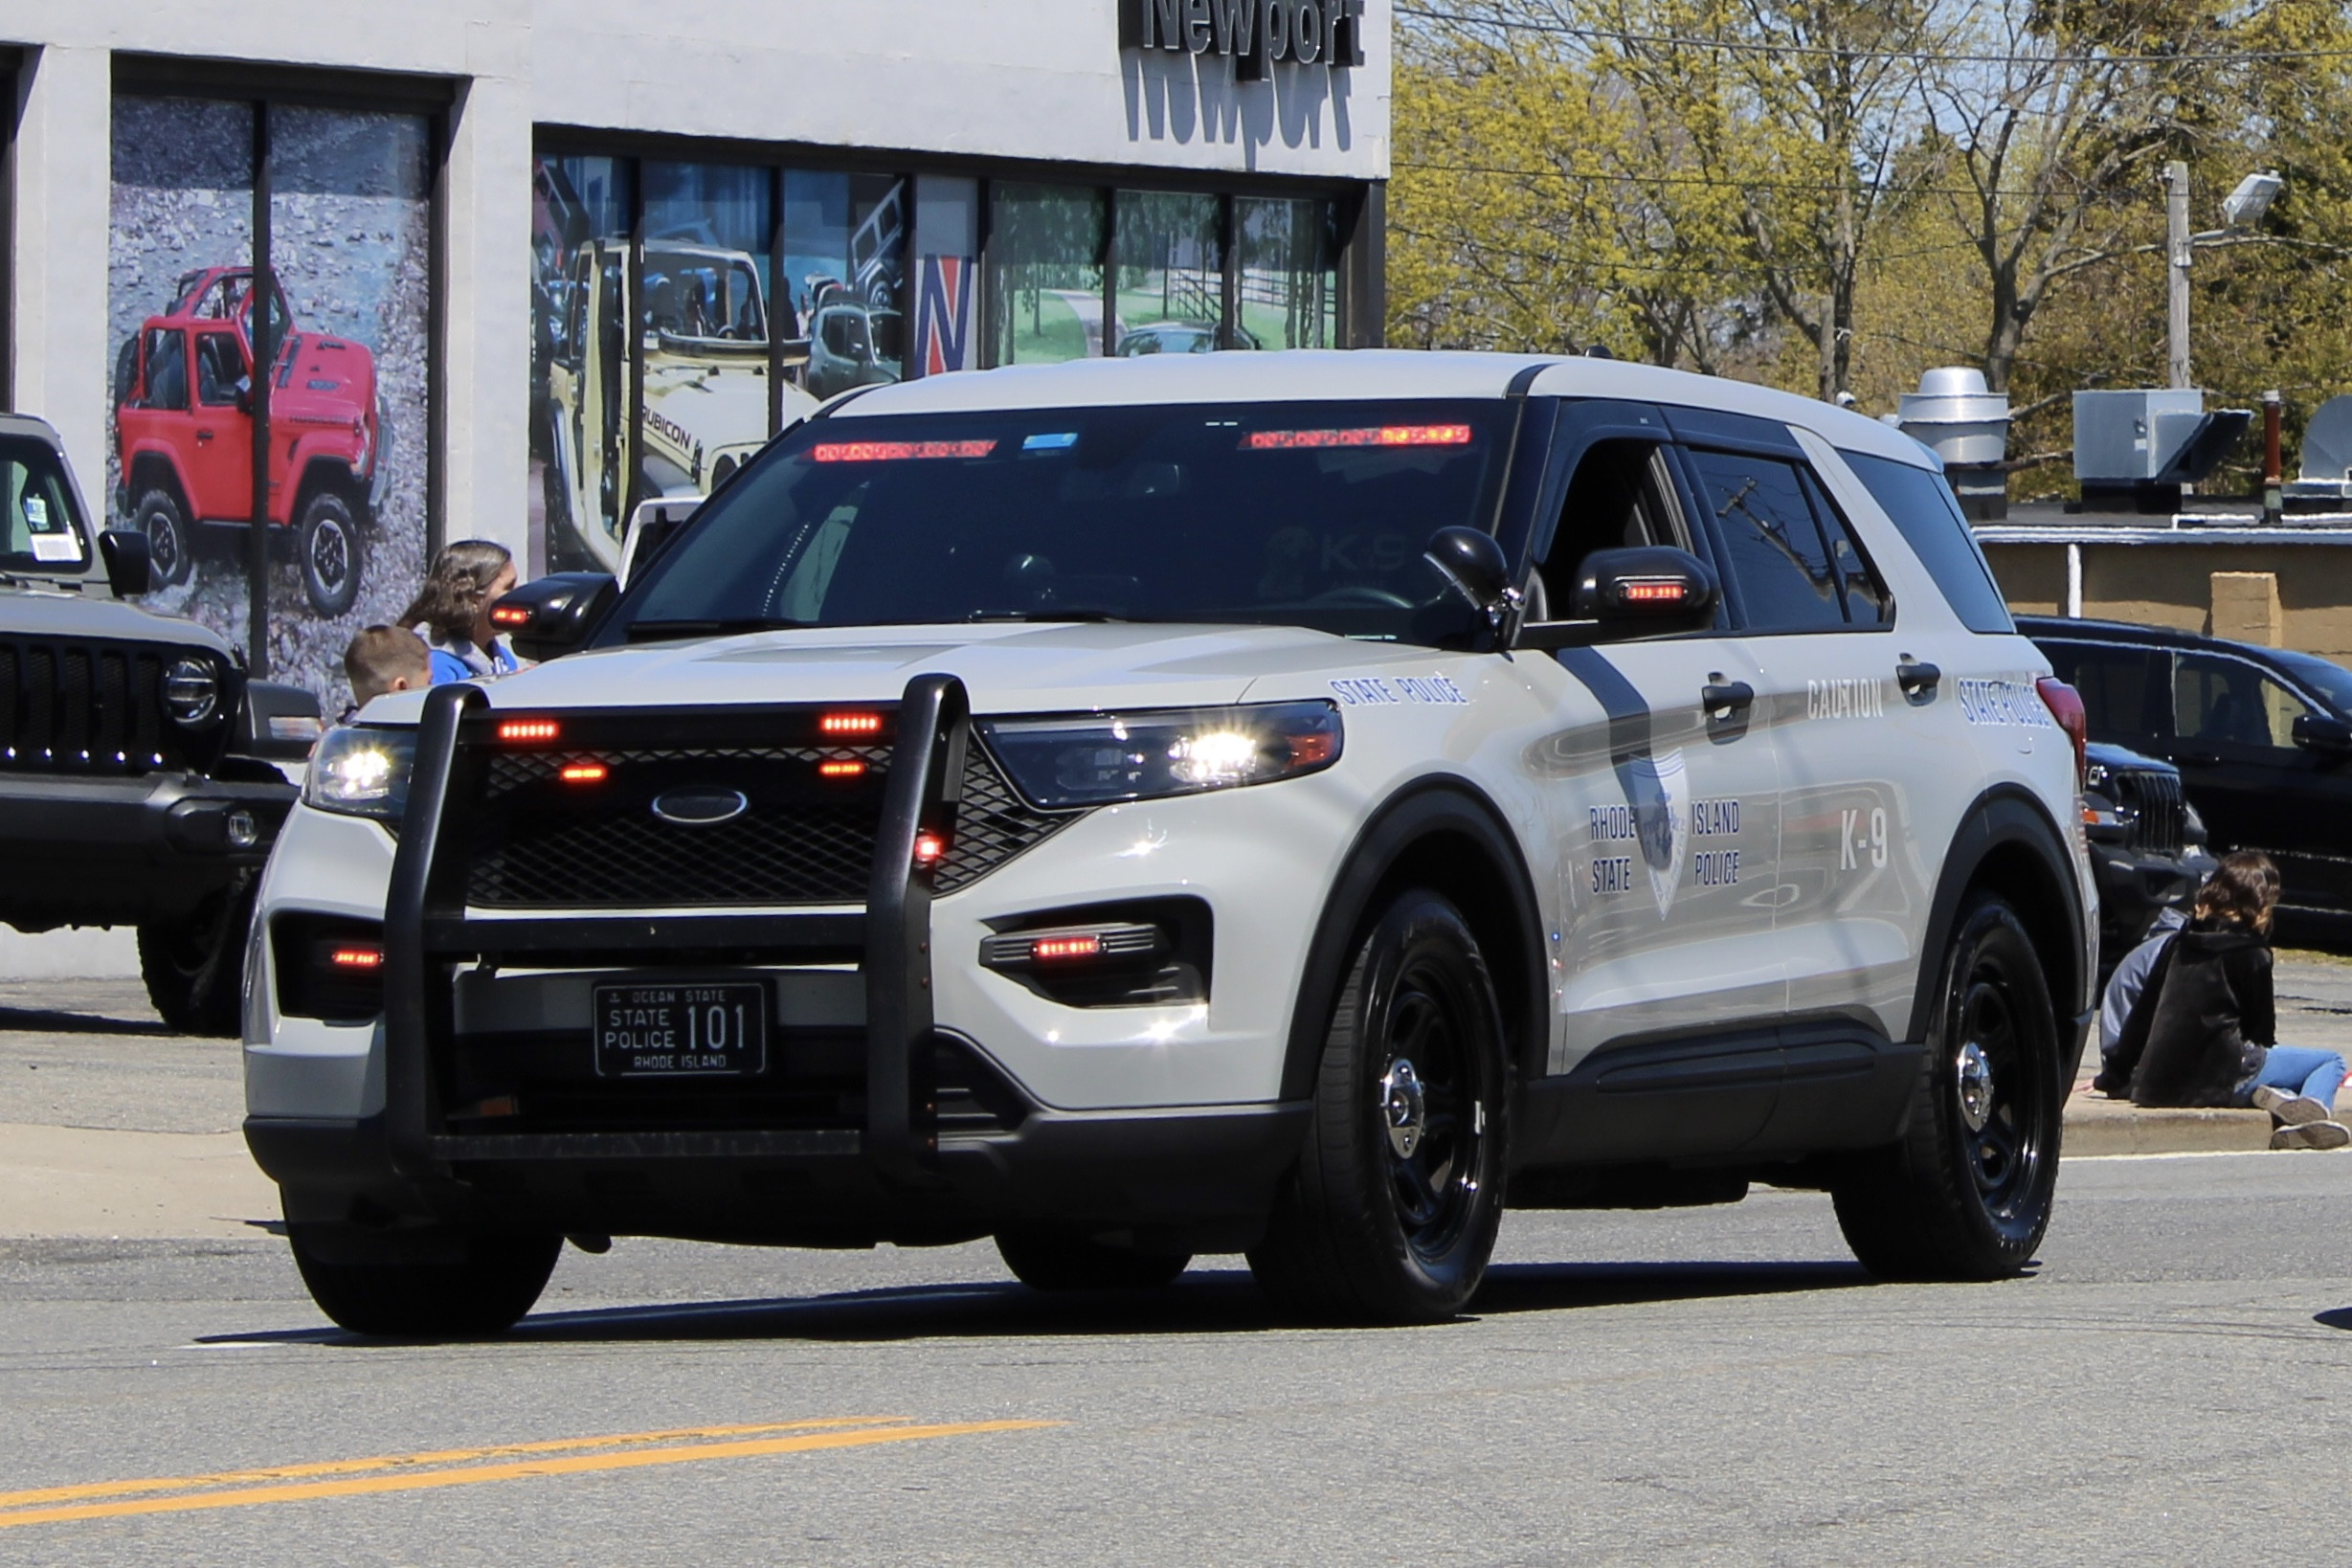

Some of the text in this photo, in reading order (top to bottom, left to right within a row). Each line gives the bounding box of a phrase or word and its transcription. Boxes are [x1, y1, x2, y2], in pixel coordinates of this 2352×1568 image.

[1143, 0, 1366, 81] Newport
[642, 405, 691, 451] RUBICON
[1329, 676, 1469, 706] STATE POLICE
[1807, 678, 1884, 720] CAUTION
[1959, 678, 2051, 729] STATE POLICE
[1589, 799, 1740, 840] RHODE ISLAND
[1840, 807, 1888, 870] K-9
[1592, 850, 1739, 894] STATE POLICE
[632, 989, 727, 1003] OCEAN STATE
[609, 1008, 670, 1027] STATE
[687, 1004, 744, 1050] 101
[604, 1030, 676, 1049] POLICE
[634, 1054, 728, 1068] RHODE ISLAND
